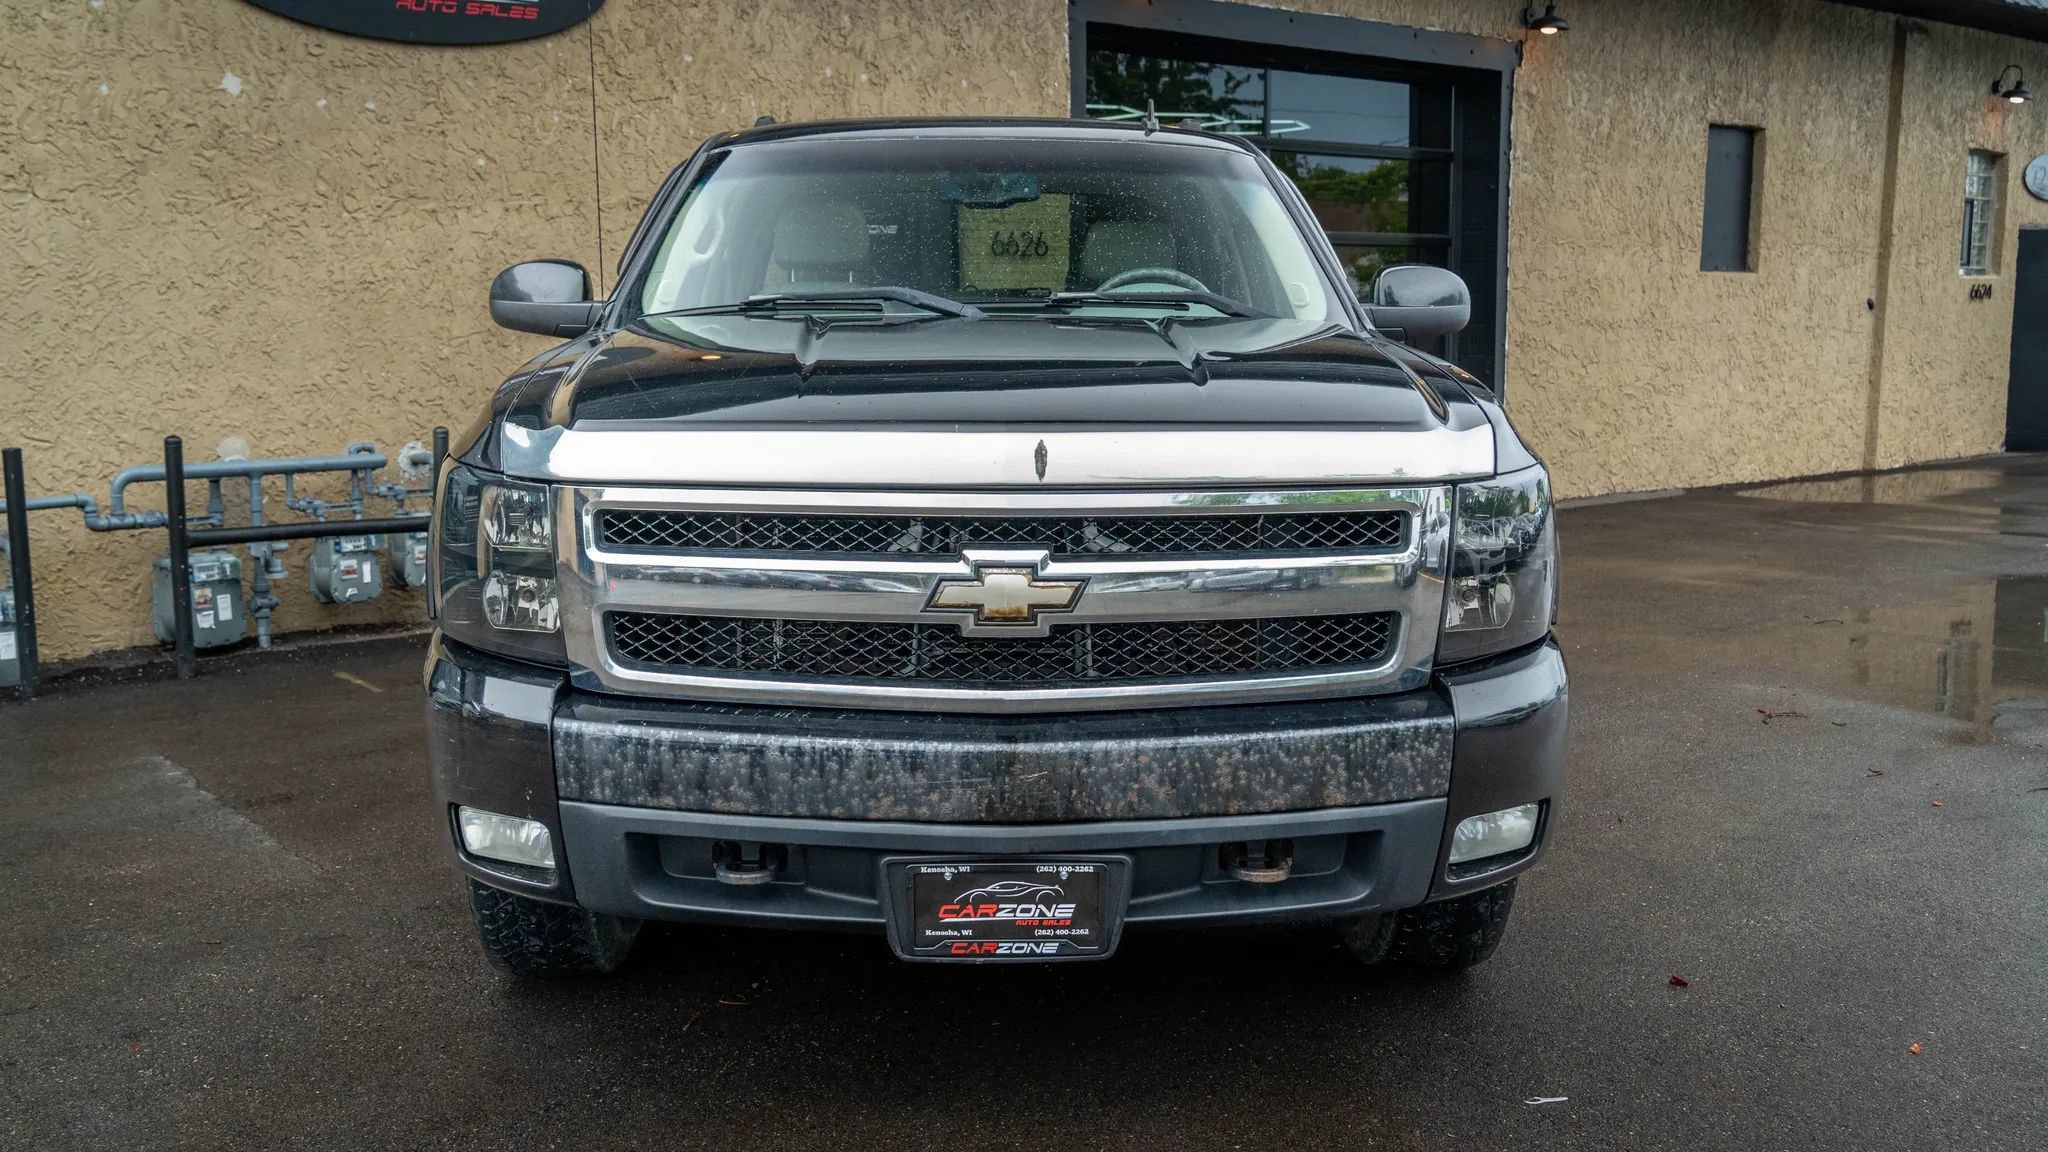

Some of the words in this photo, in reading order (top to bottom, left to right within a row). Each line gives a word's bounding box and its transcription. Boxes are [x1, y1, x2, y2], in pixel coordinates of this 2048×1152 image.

[396, 0, 457, 13] AUTO
[466, 3, 539, 19] SALES
[991, 231, 1049, 257] 6626
[1970, 283, 1992, 300] 6624
[920, 865, 958, 874] Kenosha,
[958, 865, 971, 873] WI
[1036, 865, 1057, 873] (262)
[1057, 865, 1094, 873] 400-2262
[938, 903, 1077, 918] CARZONE
[925, 929, 961, 937] Kenosha,
[1034, 928, 1054, 937] (262)
[1054, 928, 1090, 936] 400-2262
[951, 942, 1060, 954] CARZONE
